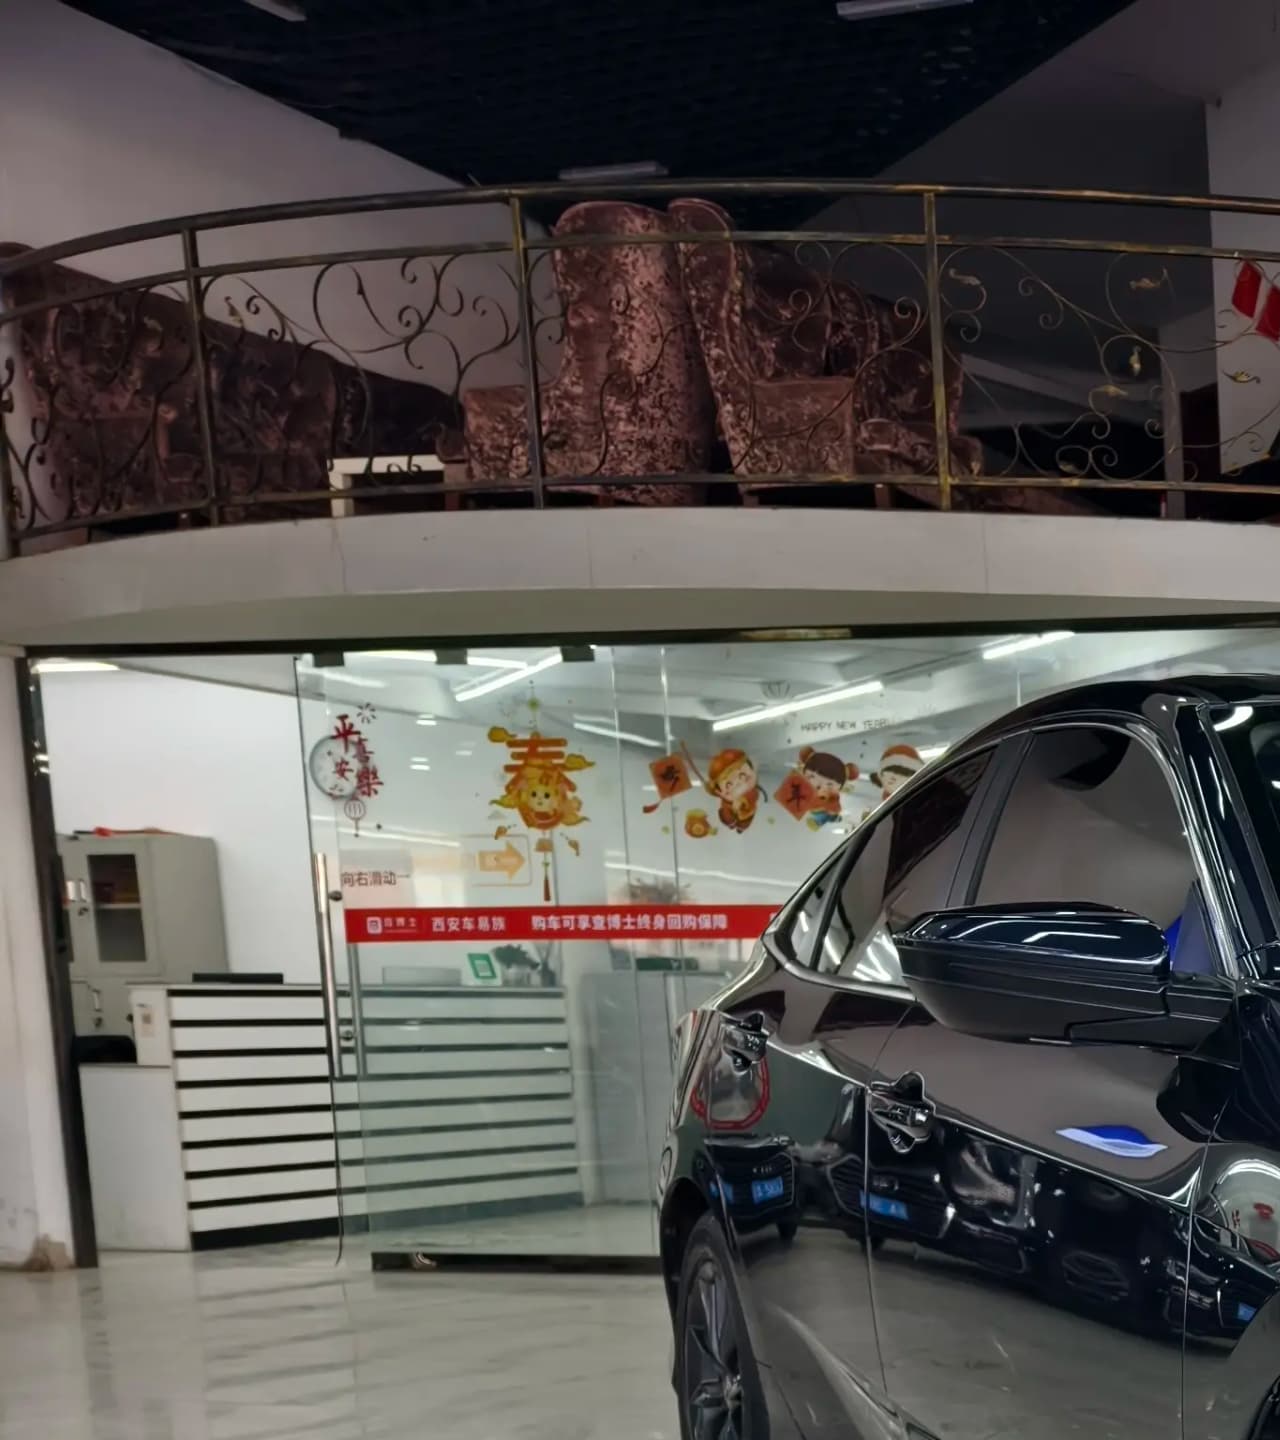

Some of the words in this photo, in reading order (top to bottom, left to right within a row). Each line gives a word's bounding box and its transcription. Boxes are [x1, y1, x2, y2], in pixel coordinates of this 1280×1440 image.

[431, 915, 506, 932] 西安车易族
[531, 913, 727, 932] 购车可享查博士终身回购保障
